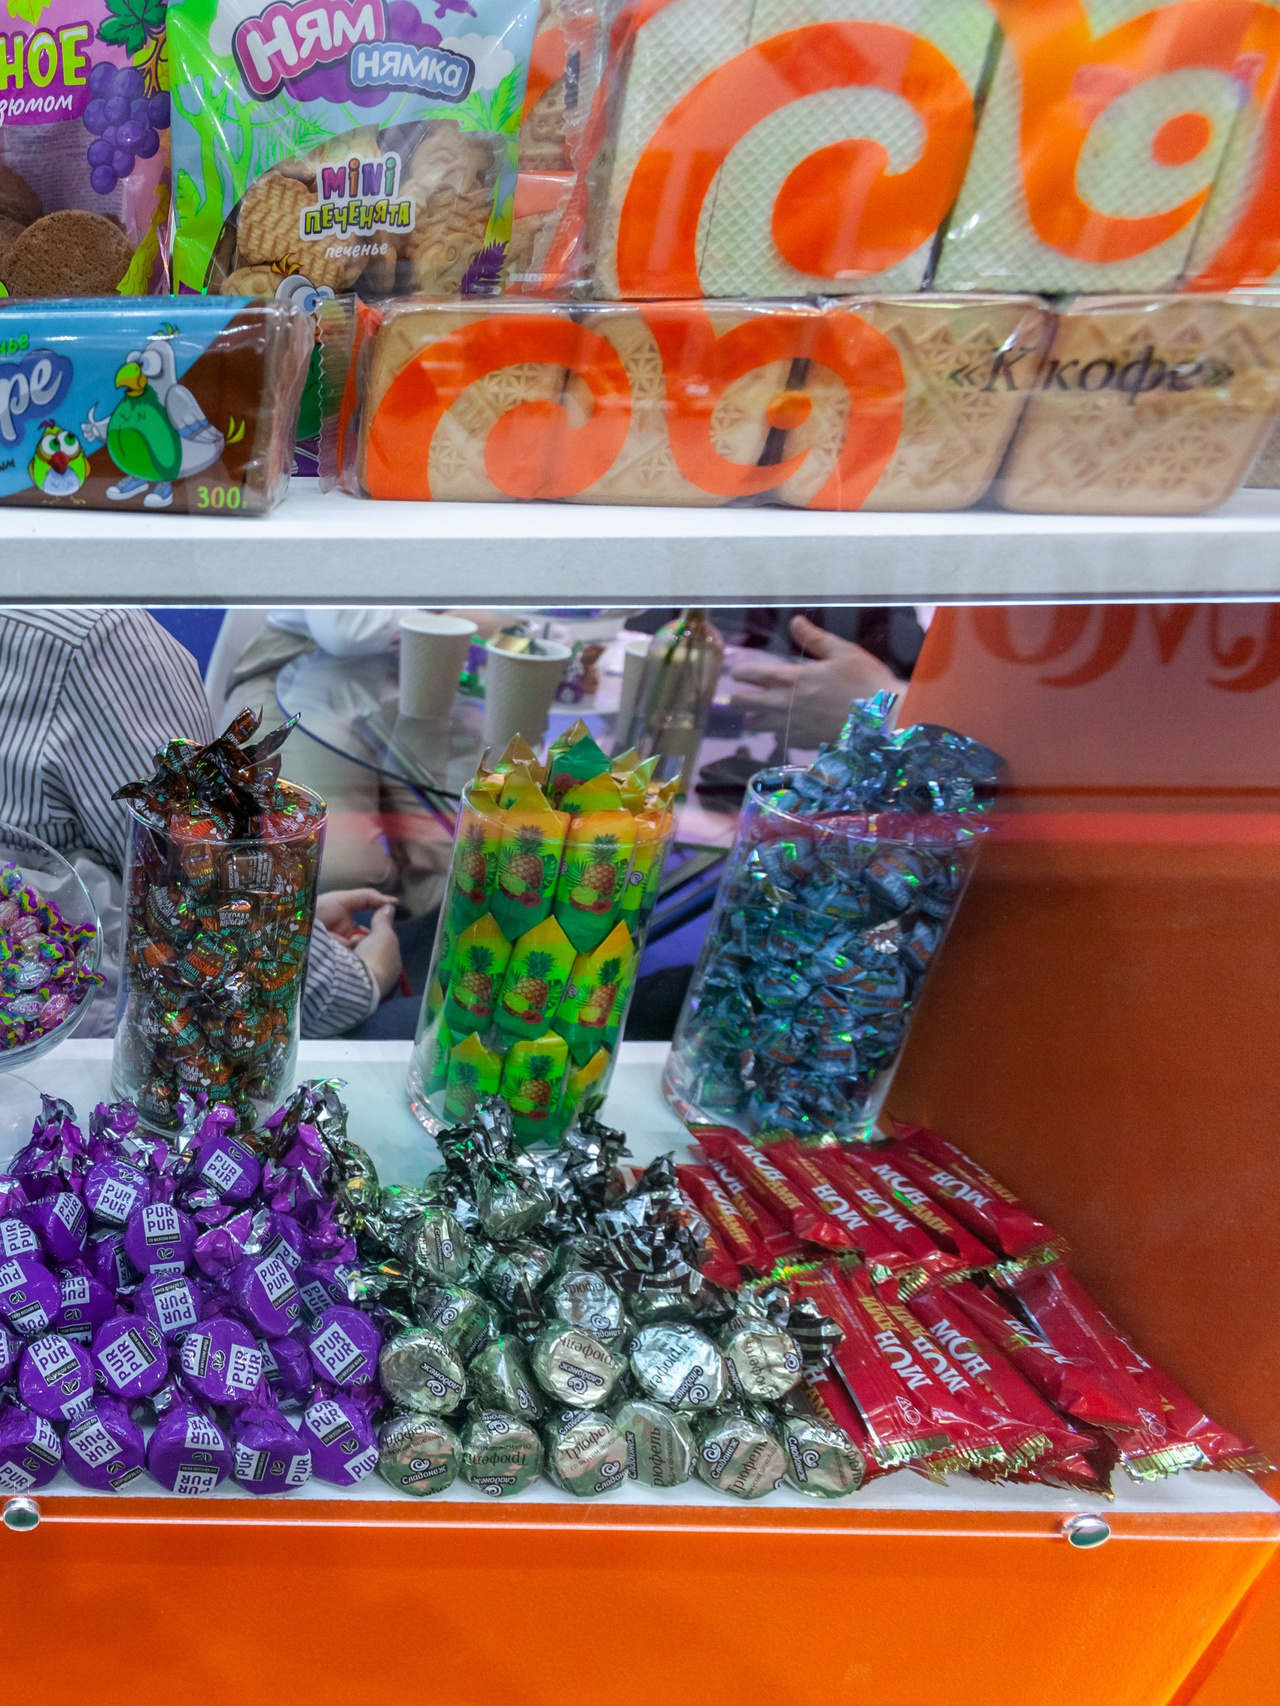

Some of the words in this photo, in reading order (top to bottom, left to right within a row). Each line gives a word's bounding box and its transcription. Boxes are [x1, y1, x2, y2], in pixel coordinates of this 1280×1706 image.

[246, 2, 377, 94] НЯМ
[325, 242, 389, 259] печенье
[207, 1163, 232, 1185] PUR
[213, 1154, 237, 1177] PUR
[105, 1184, 132, 1203] PUR
[65, 1198, 80, 1225] PUR
[100, 1196, 127, 1216] PUR
[145, 1207, 174, 1220] PUR
[148, 1219, 176, 1232] PUR
[6, 1223, 20, 1251] PUR
[260, 1260, 283, 1282] PUR
[267, 1274, 290, 1295] PUR
[159, 1292, 188, 1310] PUR
[163, 1306, 192, 1325] PUR
[32, 1335, 62, 1357] PUR
[117, 1340, 143, 1372] PUR
[183, 1338, 198, 1371] PUR
[316, 1331, 346, 1359] PUR
[39, 1345, 70, 1371] PUR
[105, 1349, 131, 1381] PUR
[326, 1343, 354, 1370] PUR
[246, 1354, 261, 1387] PUR
[311, 1408, 341, 1433] PUR
[75, 1430, 106, 1452] PUR
[191, 1432, 221, 1445] PUR
[85, 1442, 116, 1462] PUR
[649, 1428, 664, 1487] рюфель
[711, 1438, 739, 1479] Сладонеж
[788, 1437, 807, 1482] Сладонеж
[237, 1450, 255, 1477] PUR
[294, 1458, 309, 1483] PUR
[0, 1467, 28, 1487] PUR
[181, 1475, 212, 1486] PUR
[401, 1465, 447, 1485] Сладонеж
